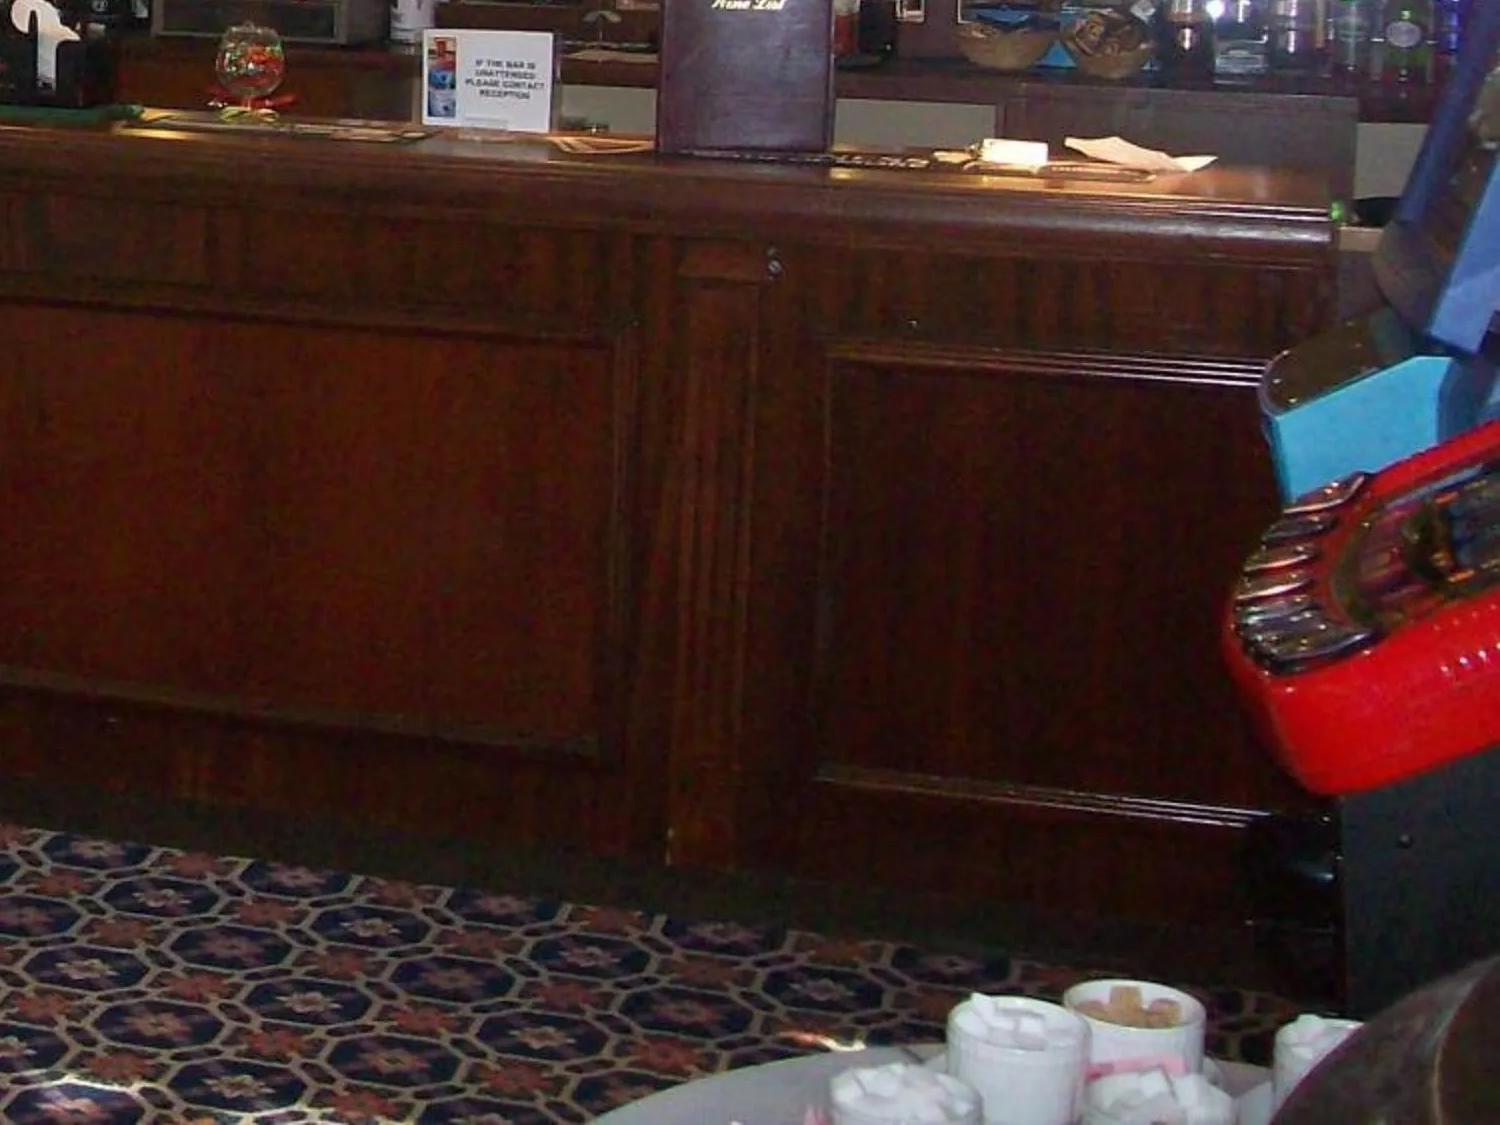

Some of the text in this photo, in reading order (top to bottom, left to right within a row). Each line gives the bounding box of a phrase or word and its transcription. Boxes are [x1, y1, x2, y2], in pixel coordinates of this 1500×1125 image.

[486, 59, 503, 68] THE
[505, 60, 525, 69] BAR
[475, 69, 536, 80] UNATTENDED
[465, 78, 546, 91] PLEASE CONTACT
[479, 89, 531, 100] RECEPTION
